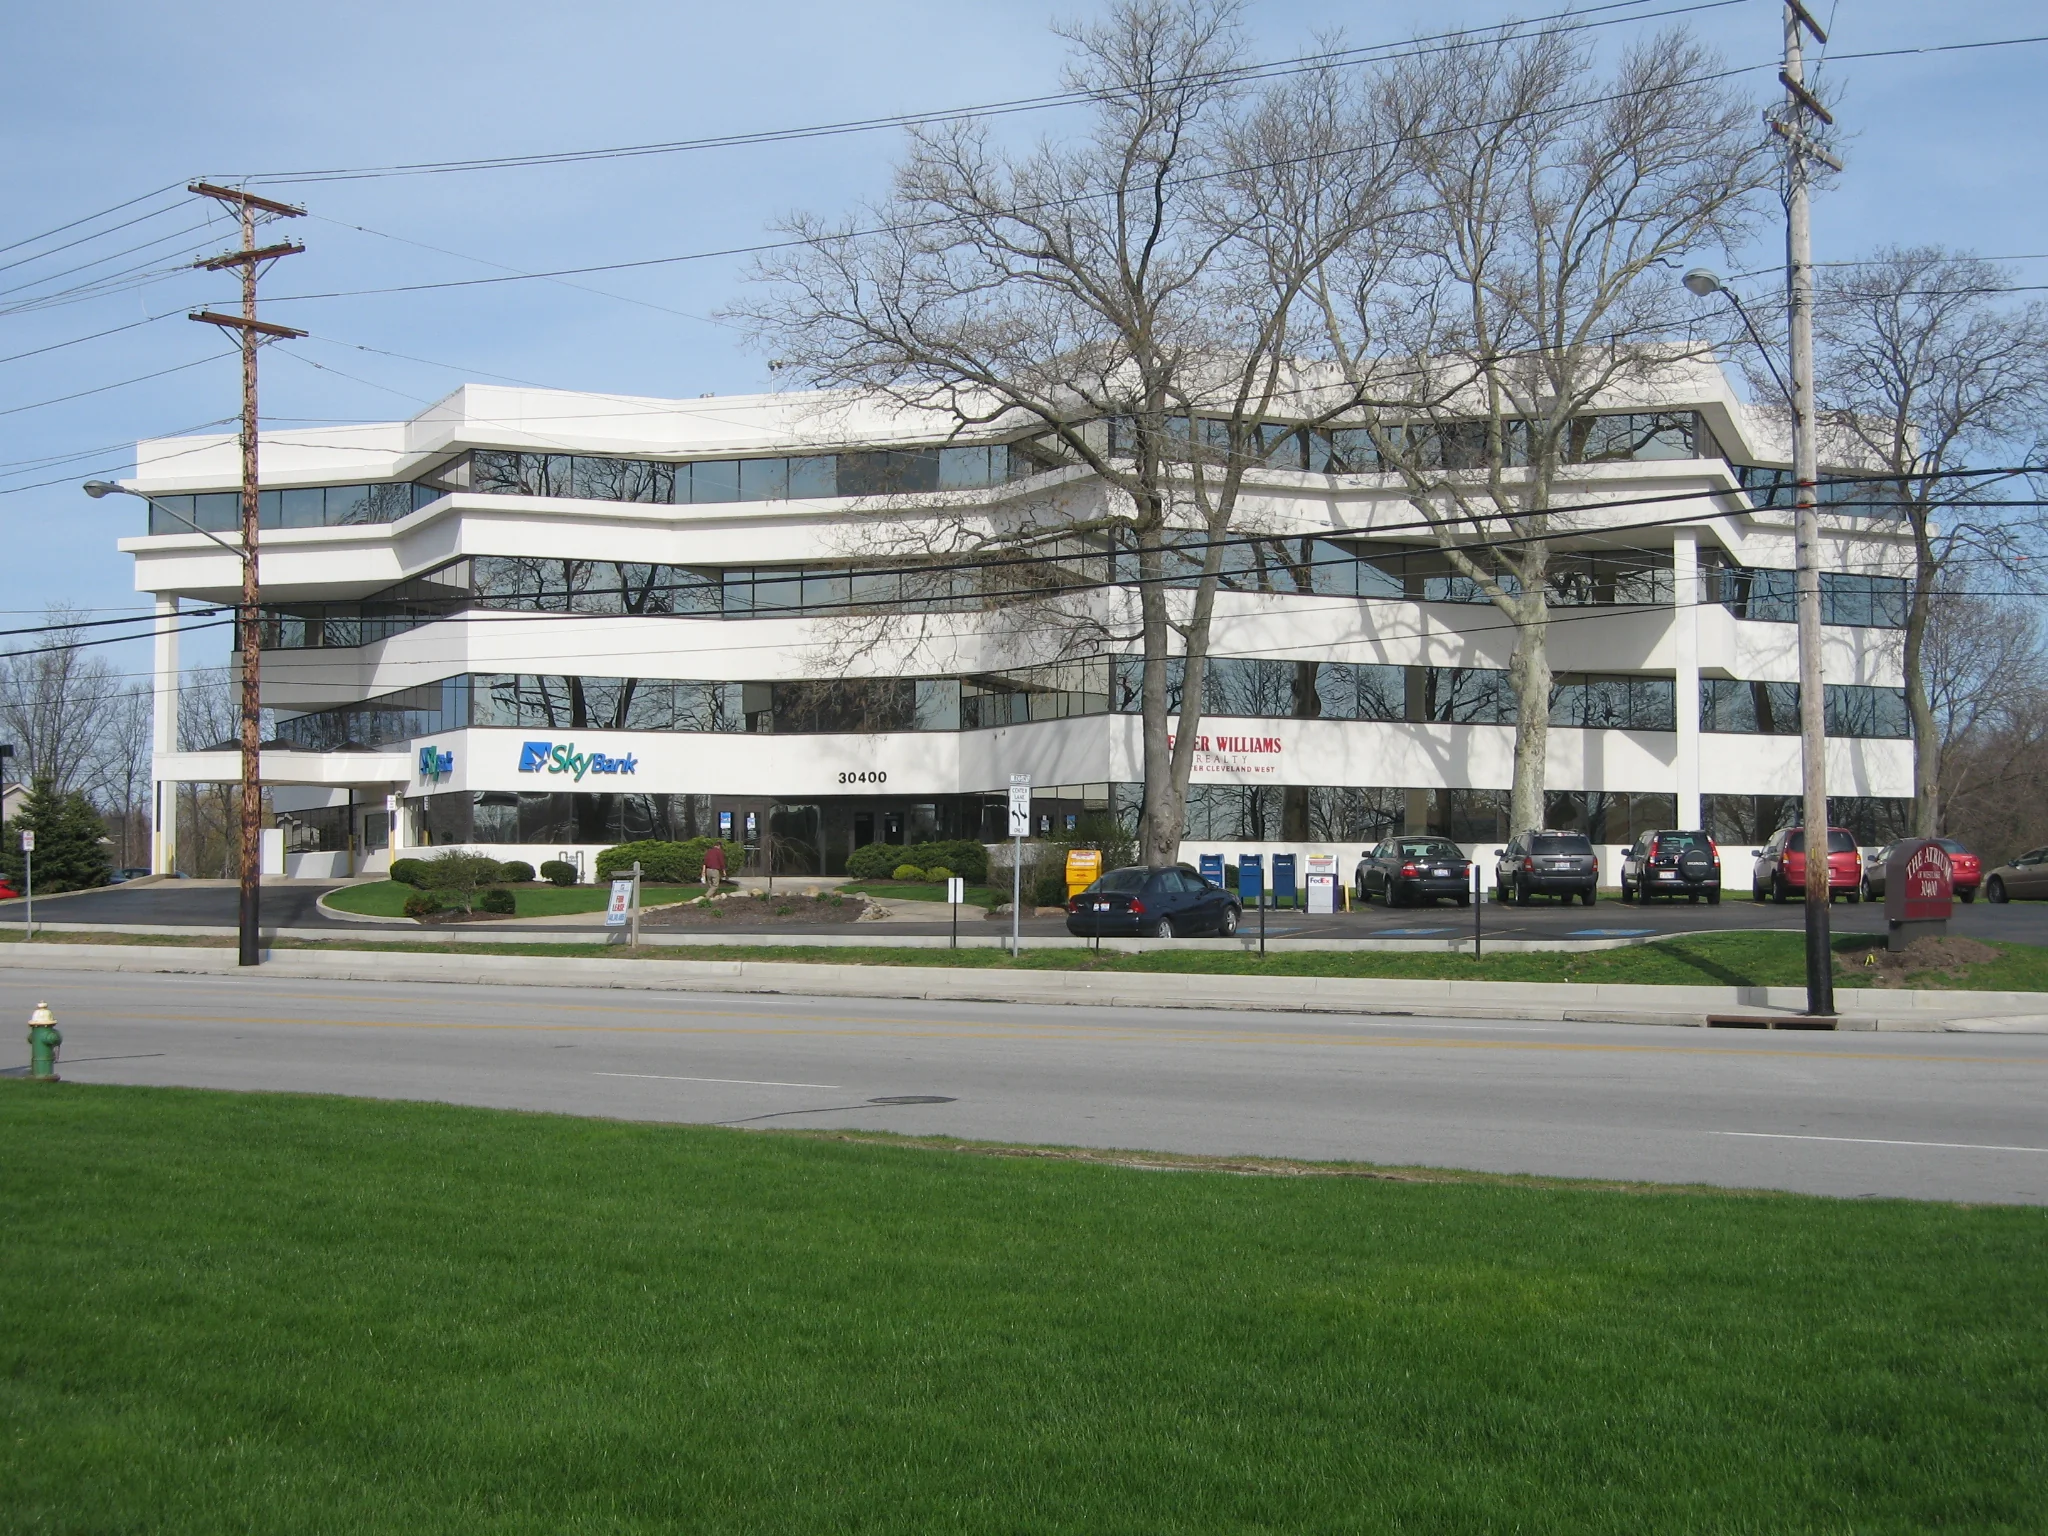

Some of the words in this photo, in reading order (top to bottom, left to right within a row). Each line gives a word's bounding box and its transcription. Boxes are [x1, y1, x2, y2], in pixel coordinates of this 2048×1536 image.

[1167, 735, 1210, 752] EER
[1216, 736, 1282, 753] WILLIAMS
[1196, 754, 1248, 764] REALTY
[1206, 765, 1252, 773] CLEVELAND
[838, 771, 888, 784] 30400
[1906, 850, 1923, 880] THE
[1924, 846, 1952, 882] ATRIUM
